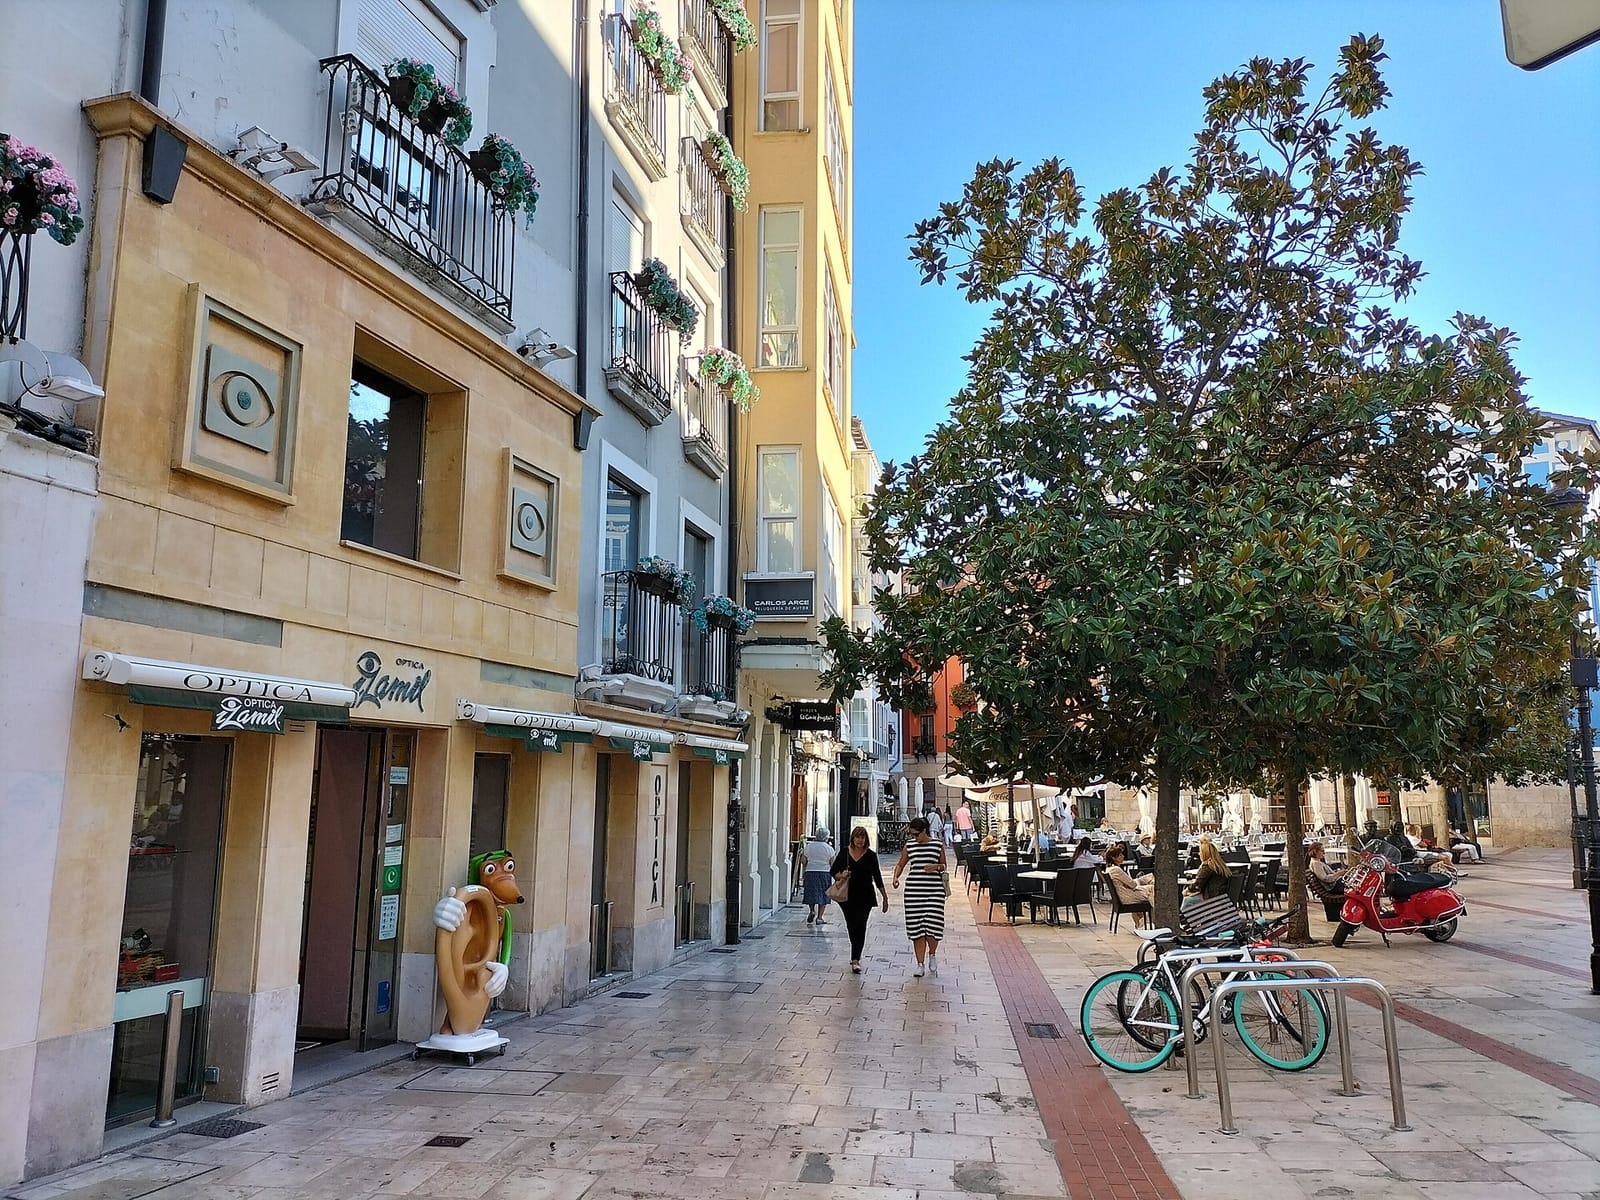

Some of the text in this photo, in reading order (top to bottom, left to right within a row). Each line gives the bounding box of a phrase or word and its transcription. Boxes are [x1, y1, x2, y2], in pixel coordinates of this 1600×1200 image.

[395, 658, 424, 670] OPTICA
[183, 673, 313, 701] OPTICA
[244, 698, 277, 709] OPTICA
[513, 715, 575, 731] OPTICA
[624, 728, 661, 742] OPTICA
[651, 775, 662, 904] OPTICA
